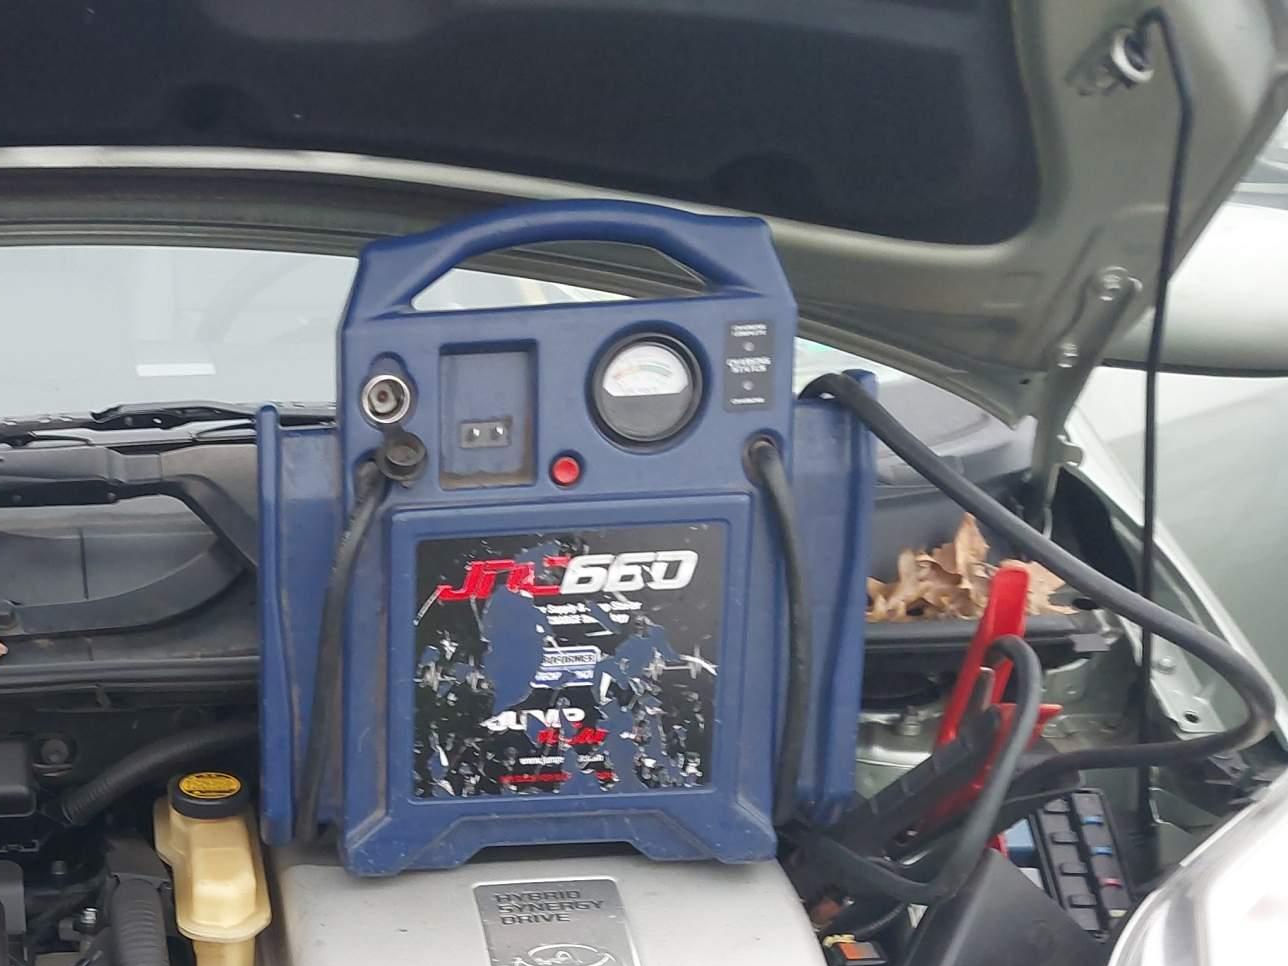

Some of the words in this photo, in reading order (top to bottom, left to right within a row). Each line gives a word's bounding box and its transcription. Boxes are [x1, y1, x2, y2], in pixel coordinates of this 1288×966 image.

[495, 890, 581, 903] HYBRID
[498, 900, 605, 914] SYNERGY
[501, 912, 571, 926] DRIVE
